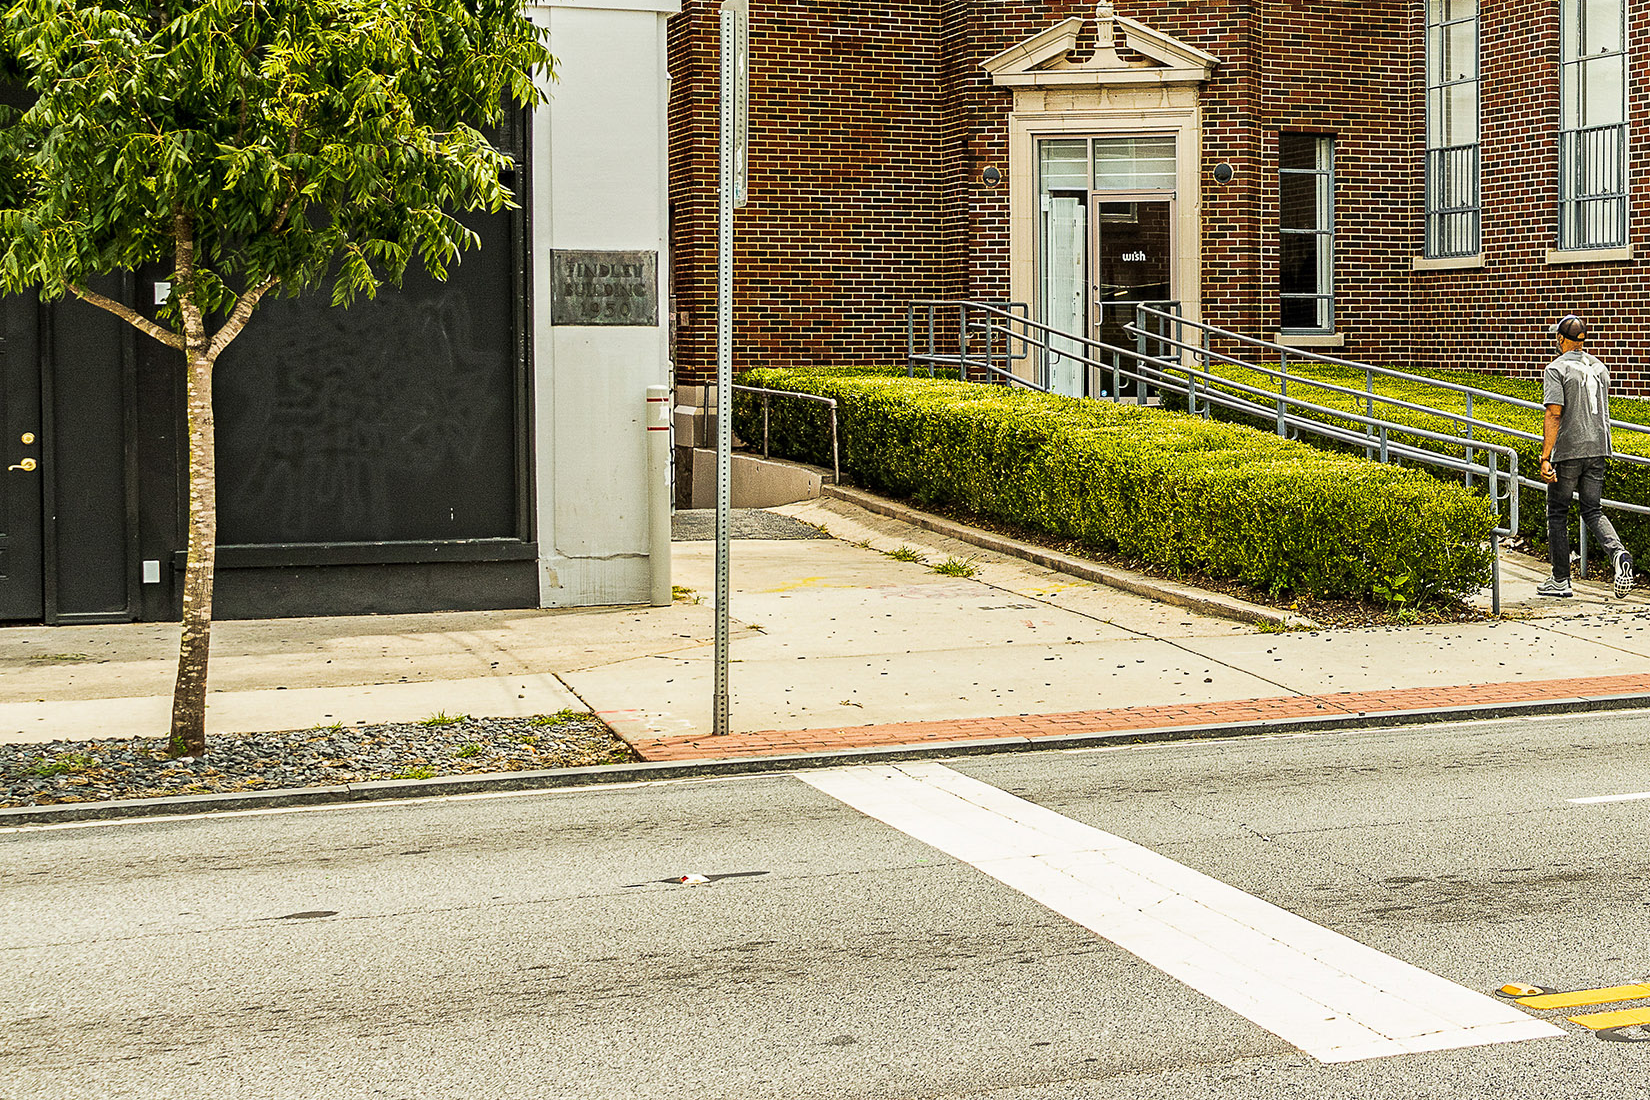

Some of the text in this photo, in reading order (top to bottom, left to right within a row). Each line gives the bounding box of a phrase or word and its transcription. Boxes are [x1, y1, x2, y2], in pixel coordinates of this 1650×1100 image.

[1122, 250, 1146, 262] wish
[566, 262, 645, 278] FINDLEY
[563, 282, 647, 297] BUILDING
[581, 301, 632, 318] 1950
